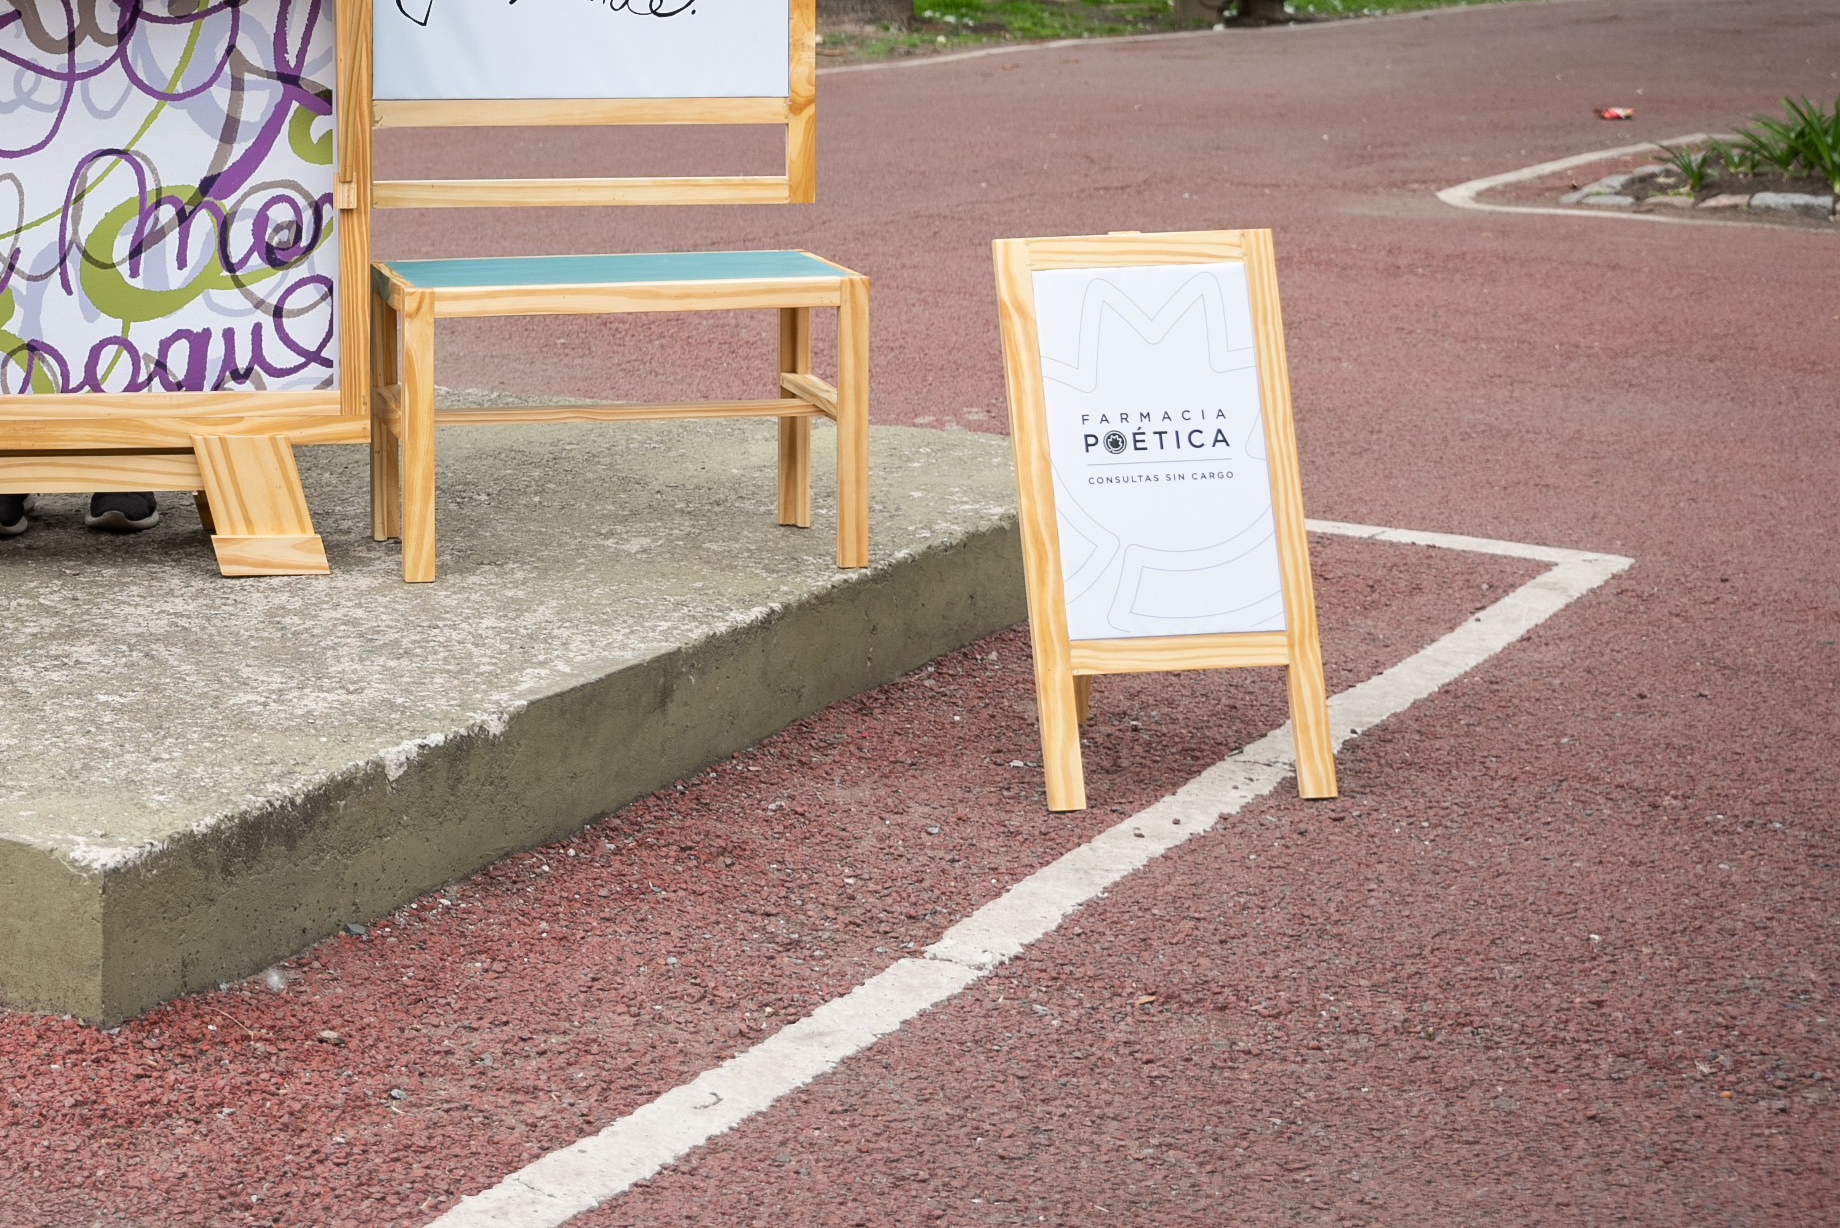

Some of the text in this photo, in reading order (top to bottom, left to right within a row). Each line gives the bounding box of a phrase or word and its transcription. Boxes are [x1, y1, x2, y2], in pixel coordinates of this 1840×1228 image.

[1081, 408, 1226, 425] FARMACIA
[1084, 426, 1230, 454] POÉTICA
[1088, 471, 1234, 485] CONSULTAS SIN CARGO
